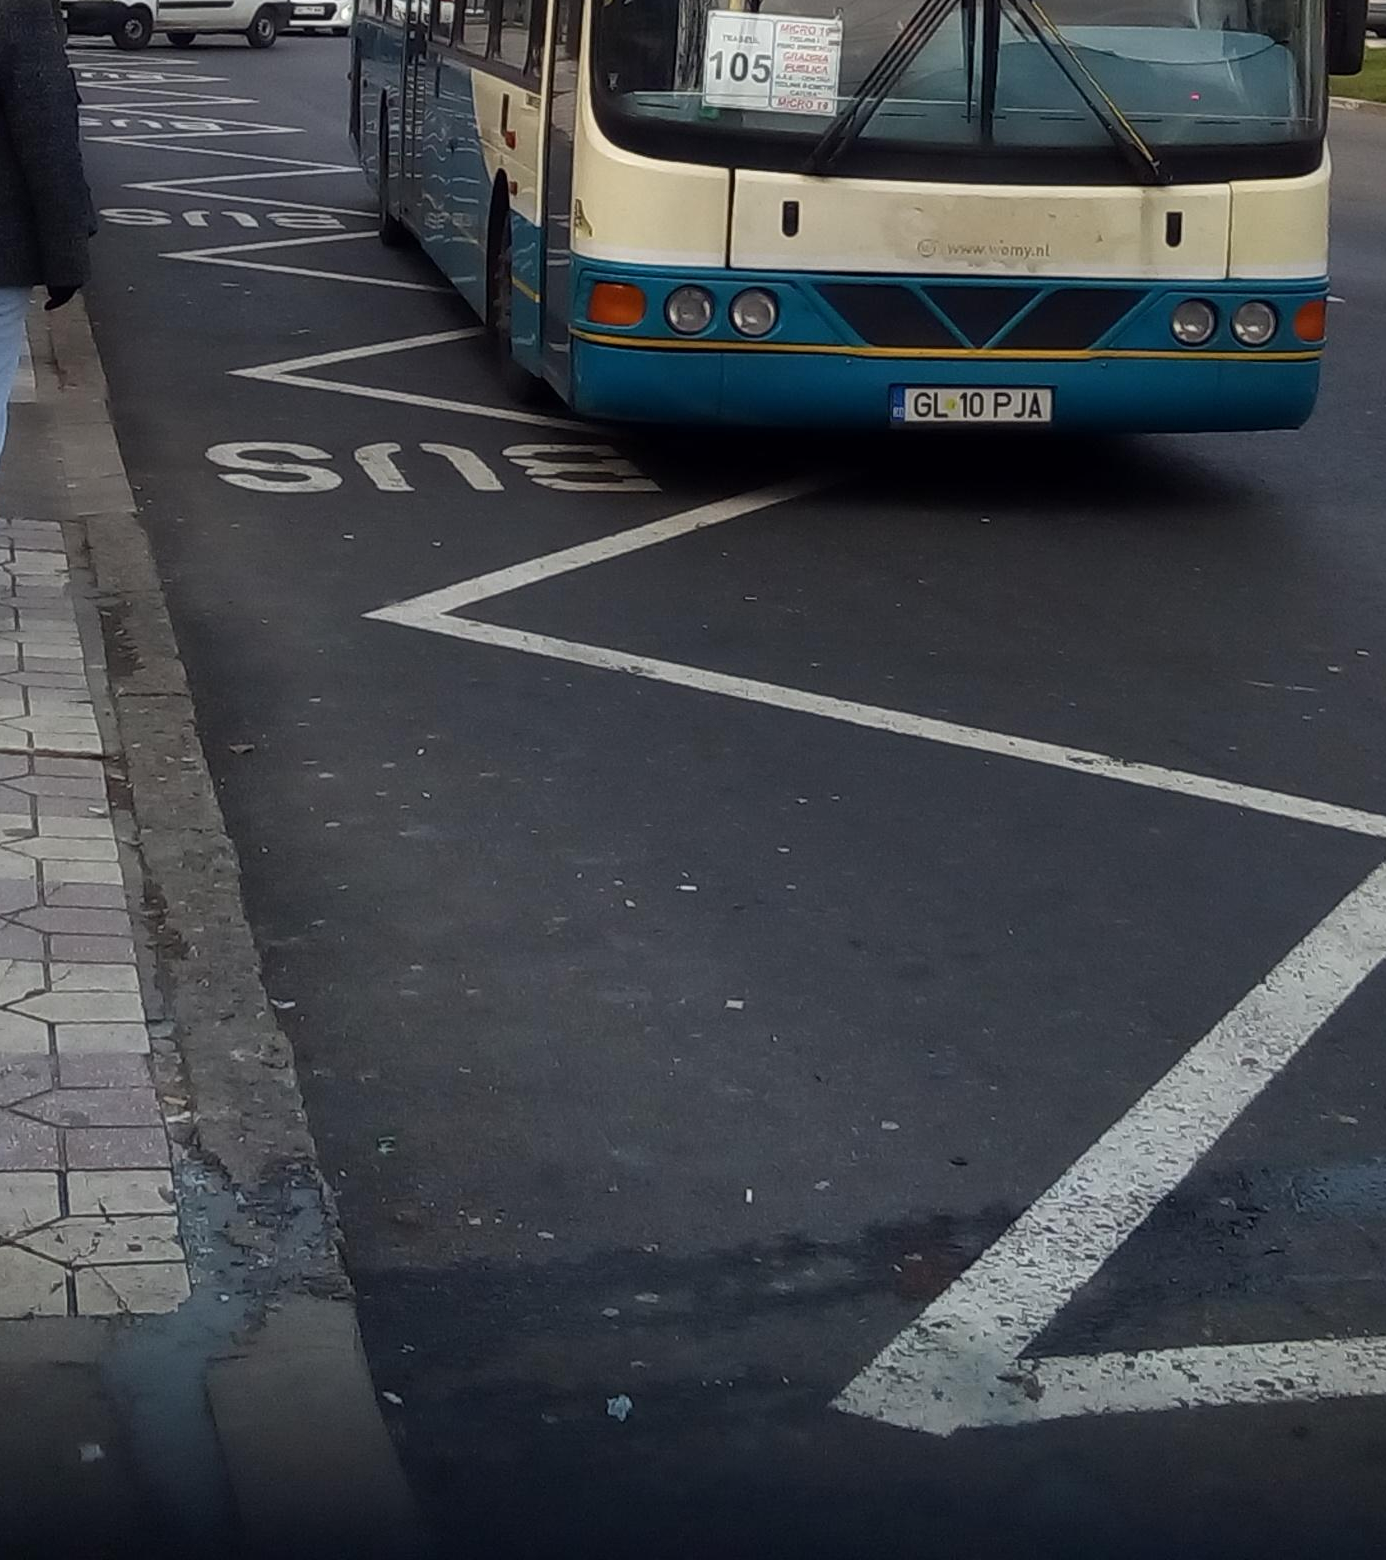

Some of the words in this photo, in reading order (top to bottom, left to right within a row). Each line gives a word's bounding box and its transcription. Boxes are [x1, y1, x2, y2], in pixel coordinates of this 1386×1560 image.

[709, 50, 771, 83] 105
[777, 96, 813, 110] MICRO
[99, 208, 345, 230] BUS
[947, 244, 1051, 258] www.womy.nl
[914, 392, 948, 418] GL
[959, 392, 984, 418] 10
[993, 392, 1043, 418] PJA
[205, 441, 663, 493] BUS
